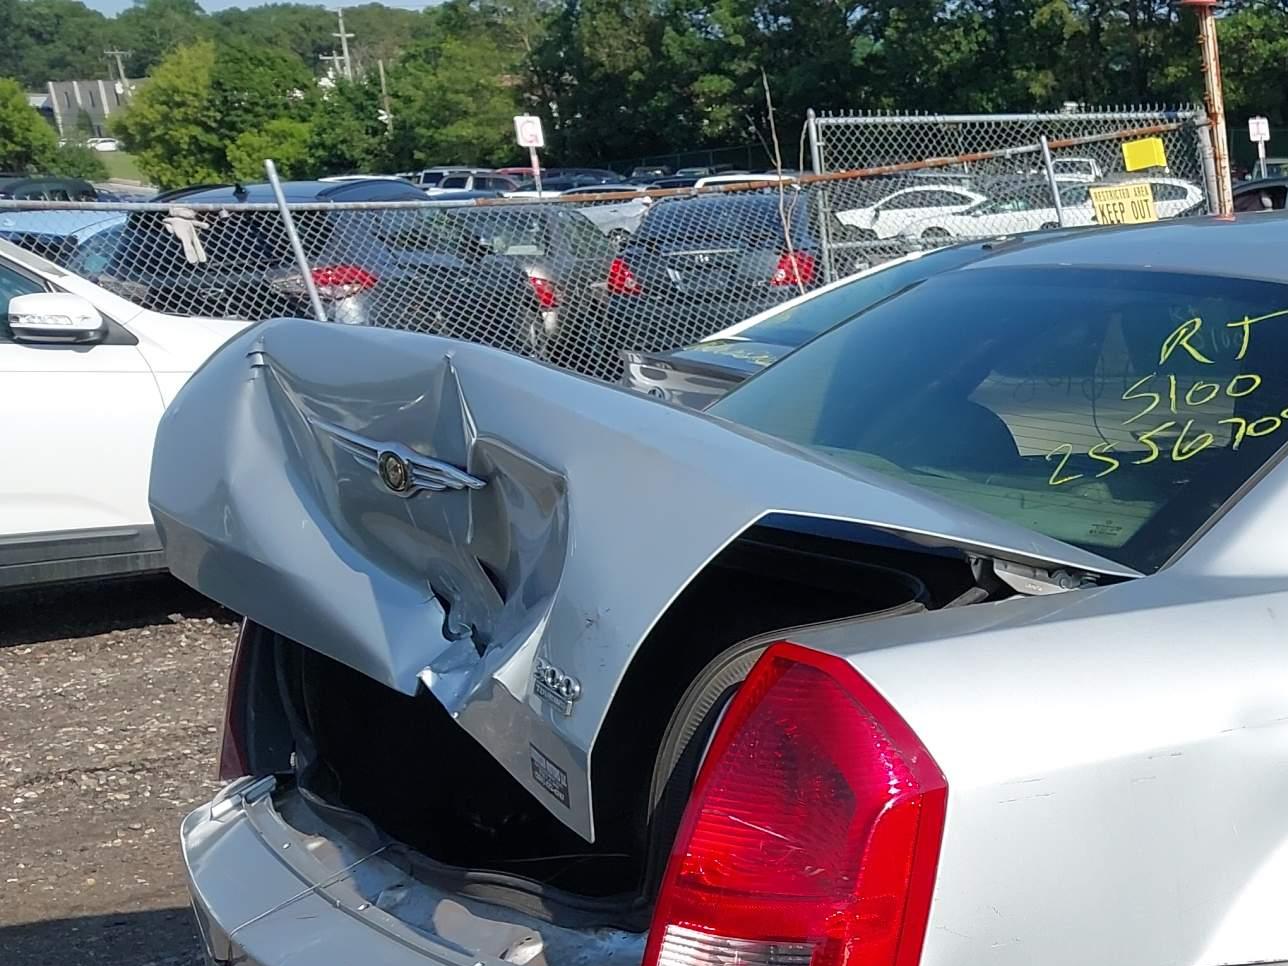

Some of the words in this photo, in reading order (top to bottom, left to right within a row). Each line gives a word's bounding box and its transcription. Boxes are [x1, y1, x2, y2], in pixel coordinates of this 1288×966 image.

[1093, 188, 1130, 202] RESTRICTED
[1133, 185, 1149, 197] AREA
[1098, 202, 1125, 225] KEEP
[1130, 199, 1152, 221] OUT
